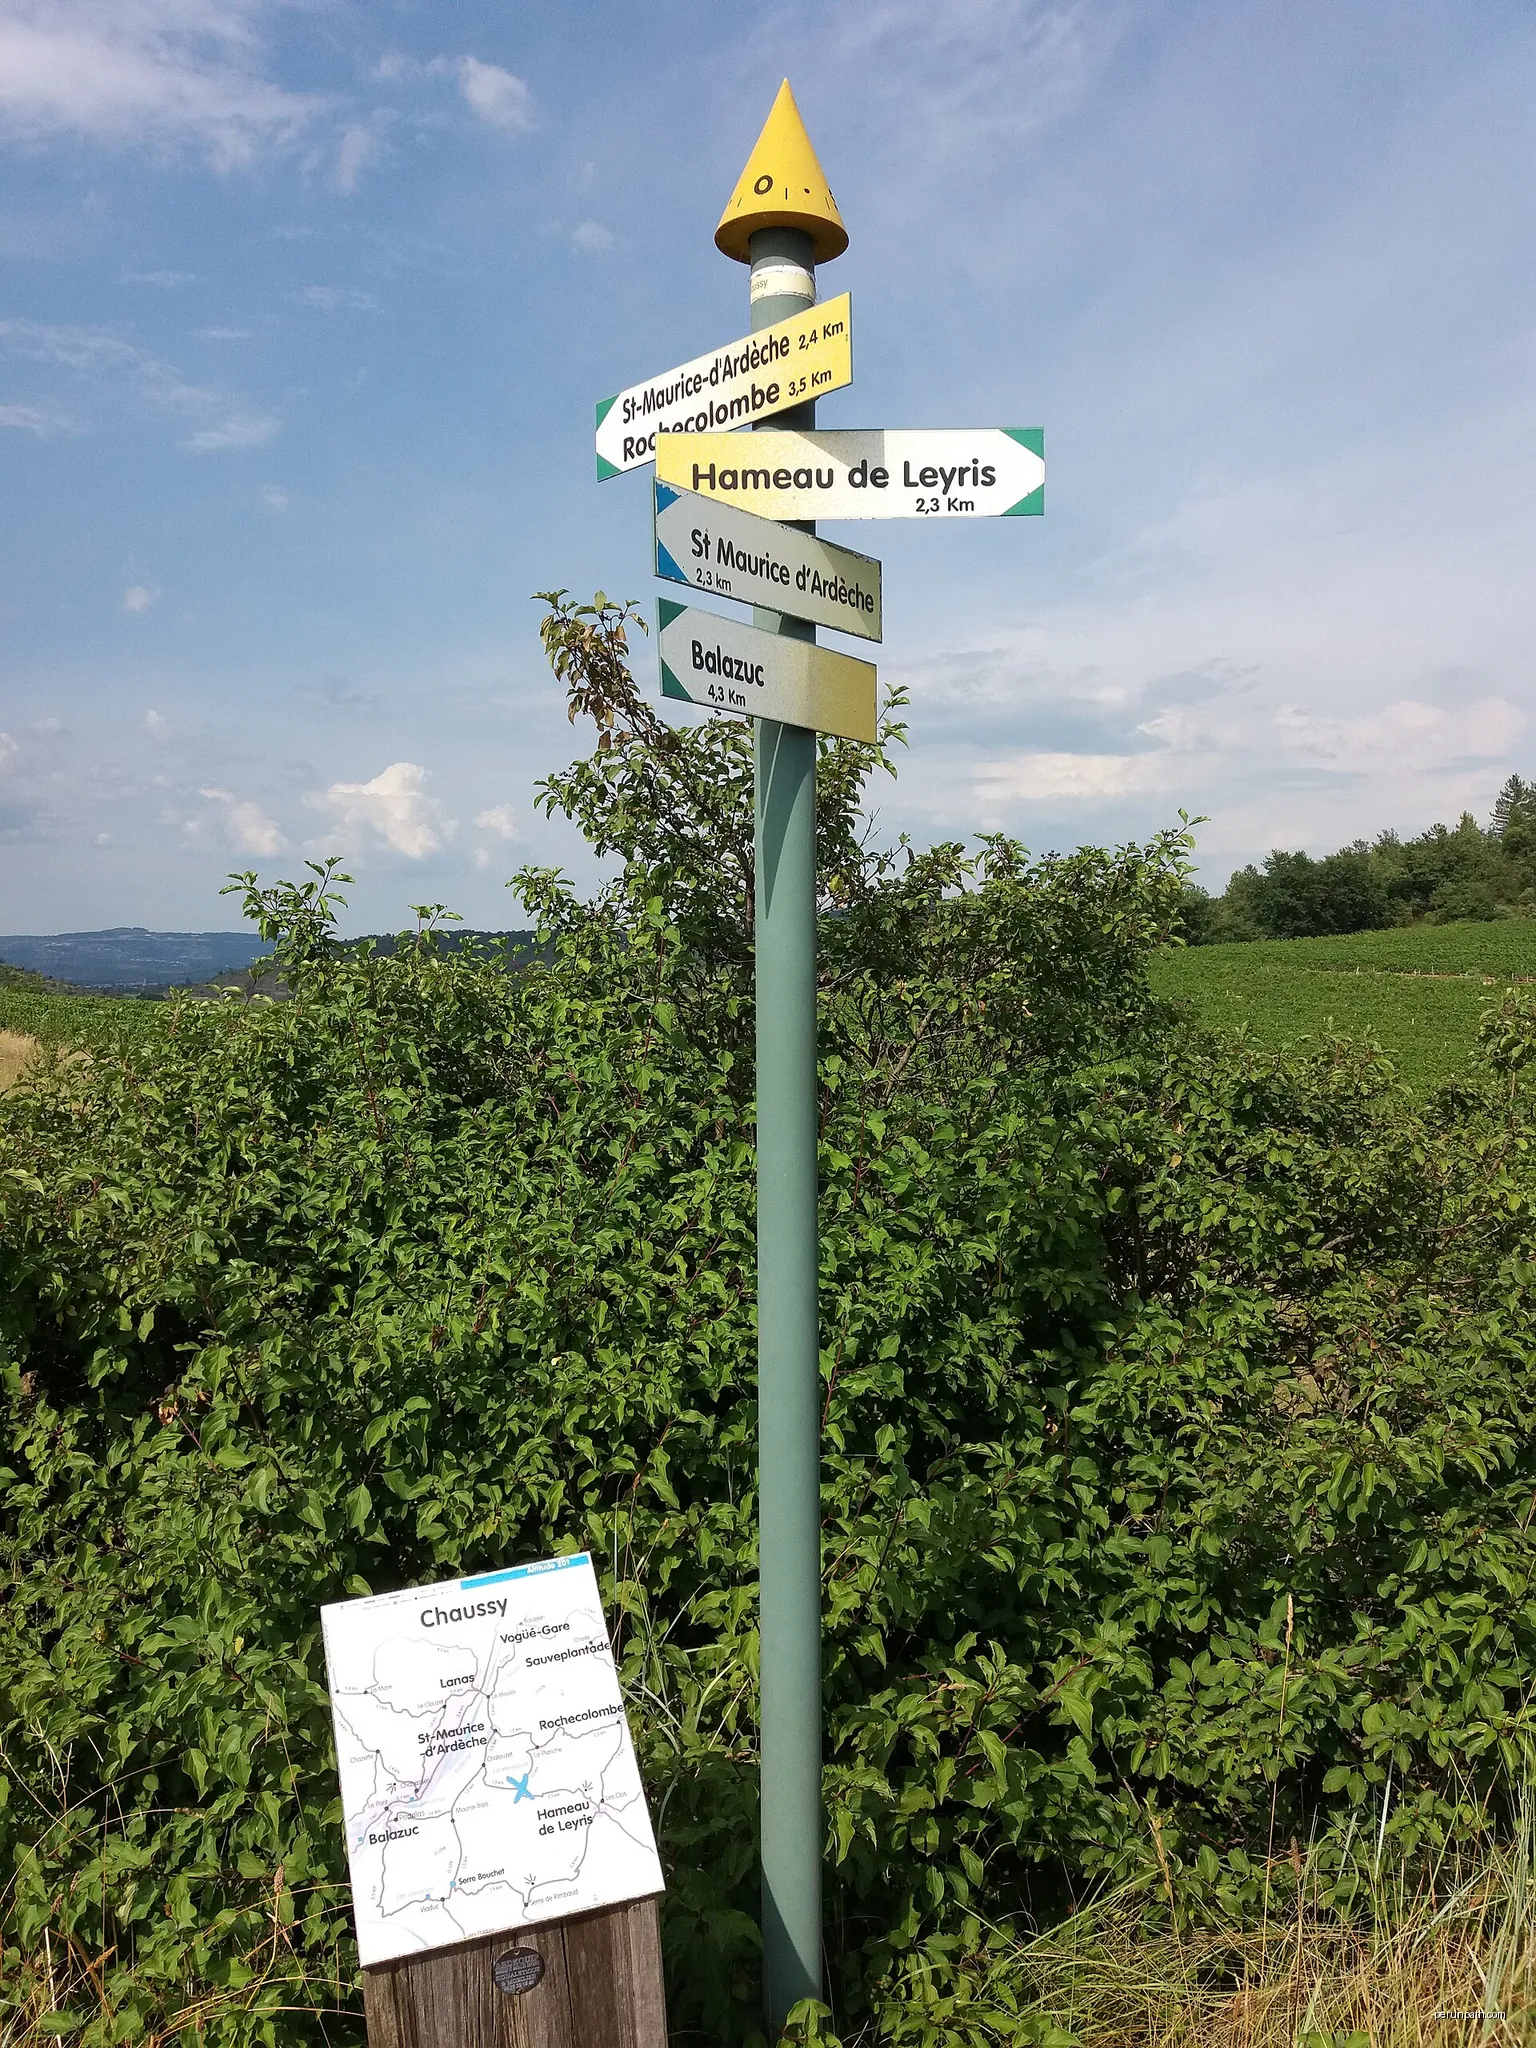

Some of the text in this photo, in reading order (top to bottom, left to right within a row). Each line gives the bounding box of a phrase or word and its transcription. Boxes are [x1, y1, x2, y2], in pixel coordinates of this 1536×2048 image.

[751, 279, 768, 293] ussy
[623, 321, 843, 424] St-Maurice-d'Ardèche 2,4 Km
[788, 376, 806, 397] 3,5
[811, 369, 832, 388] Km
[692, 458, 996, 496] Hameau de Leyris
[915, 497, 974, 515] 2,3 Km
[691, 528, 874, 613] St Maurice d'Ardèche
[696, 567, 732, 592] 2,3 km
[691, 639, 765, 687] Balazuc
[707, 684, 746, 707] 4,3 Km
[526, 1562, 556, 1575] Altitude
[420, 1598, 508, 1628] Chaussy
[500, 1623, 570, 1644] Vogüé-Gare
[525, 1640, 612, 1667] Sauveplantade
[440, 1674, 475, 1688] Lanas
[539, 1704, 624, 1730] Rochecolombe
[418, 1722, 485, 1744] St-Maurice
[537, 1801, 590, 1821] Hameau
[369, 1826, 419, 1845] Balazuc
[538, 1814, 593, 1836] de Leyris
[459, 1868, 505, 1886] Serre Bouchet
